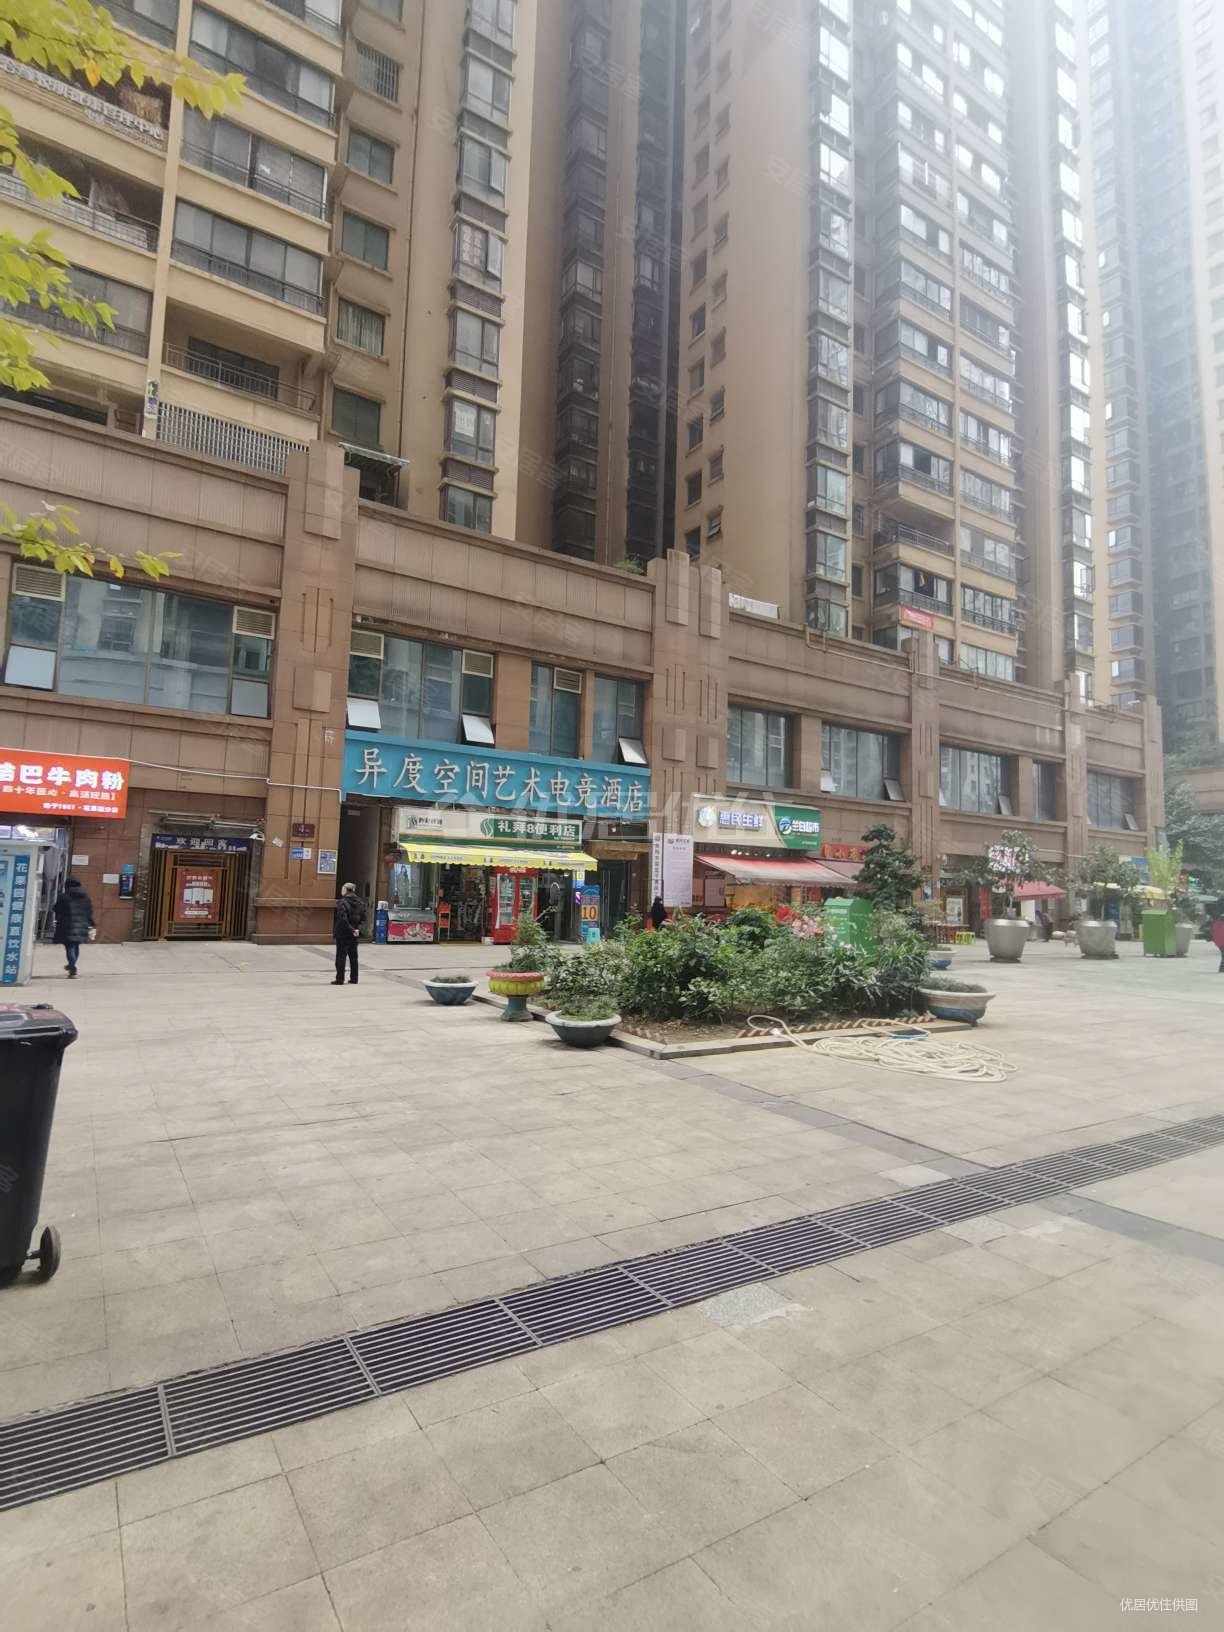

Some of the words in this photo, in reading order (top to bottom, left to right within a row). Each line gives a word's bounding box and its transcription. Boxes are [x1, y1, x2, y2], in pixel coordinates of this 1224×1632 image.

[355, 748, 643, 812] 异度空间艺术电竞酒店
[498, 820, 576, 837] 礼拜8便利店
